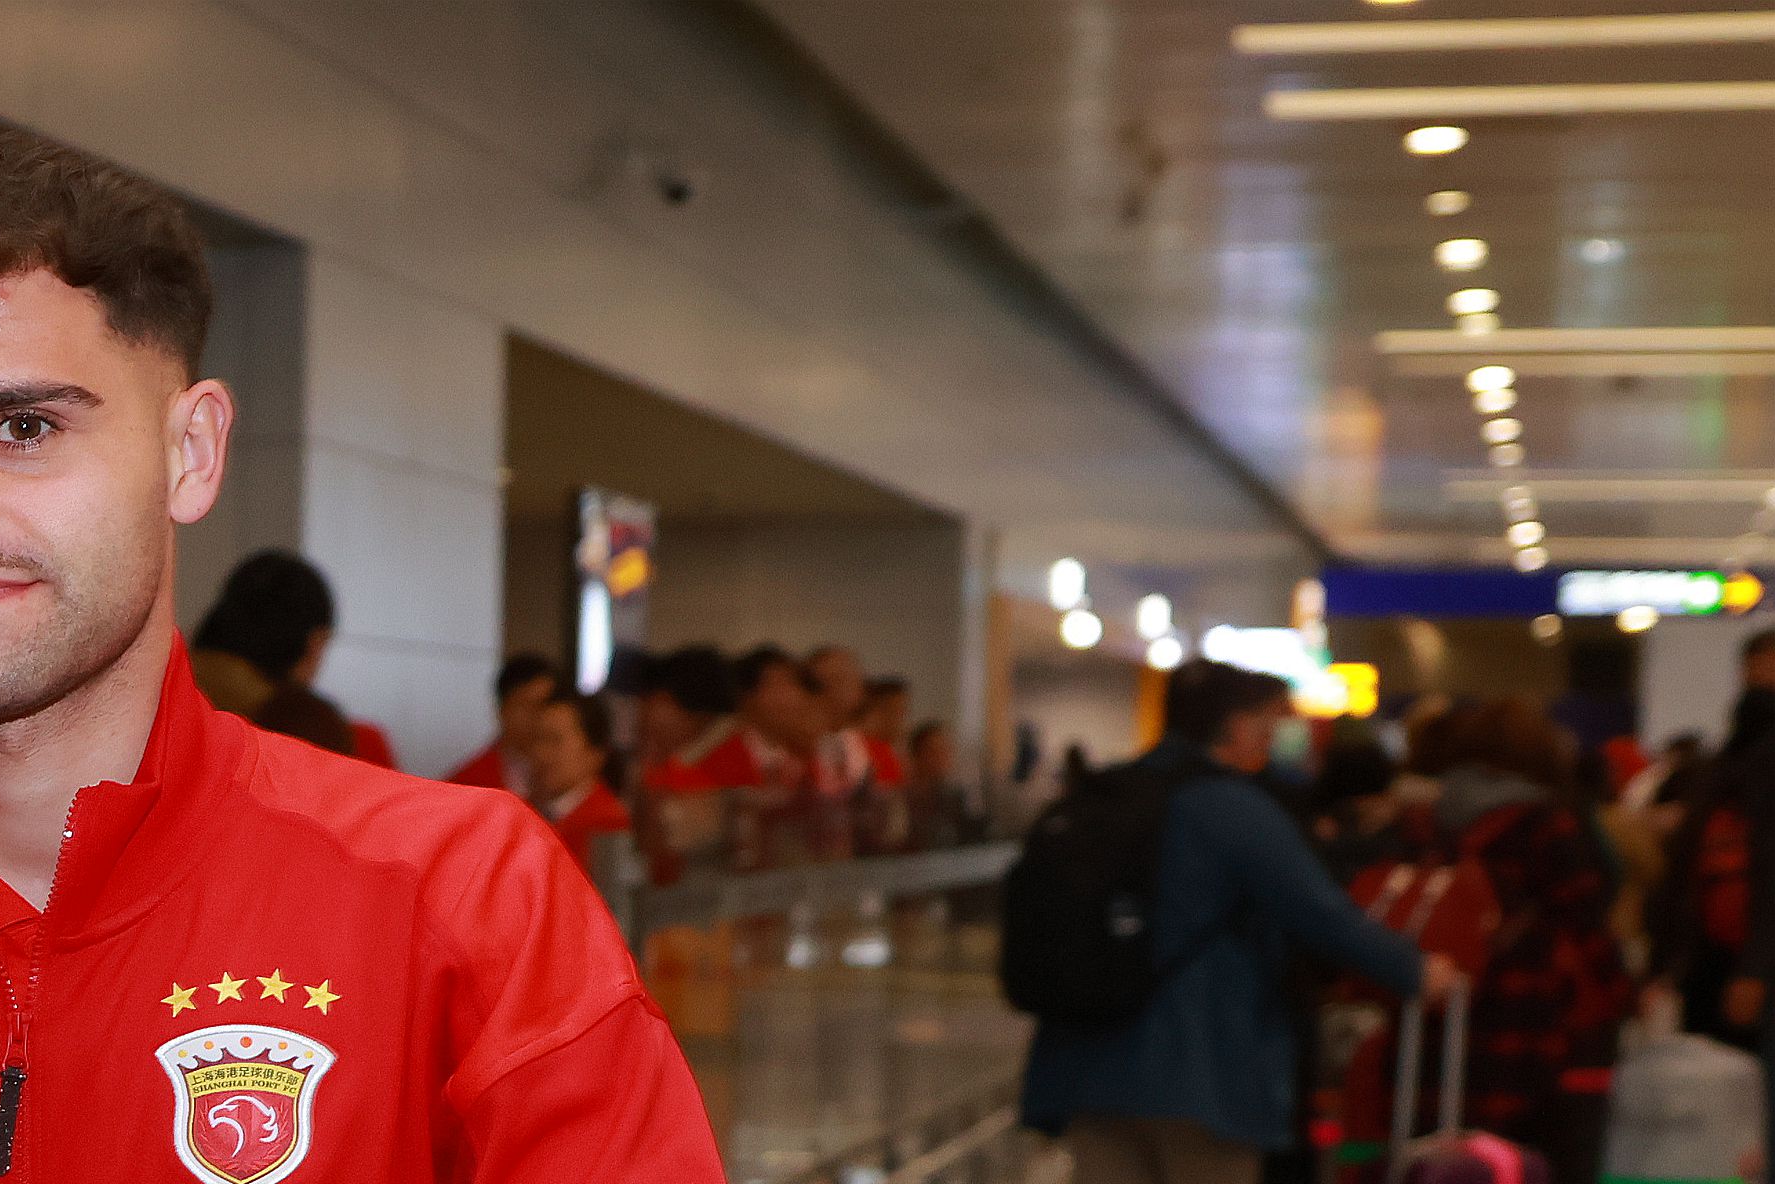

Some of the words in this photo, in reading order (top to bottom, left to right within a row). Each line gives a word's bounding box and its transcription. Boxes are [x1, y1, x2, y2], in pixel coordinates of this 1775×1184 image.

[191, 1066, 300, 1086] 上海海港足球俱乐部
[193, 1079, 247, 1094] SHANGHAI
[251, 1079, 281, 1090] PORT
[283, 1086, 297, 1095] FC
